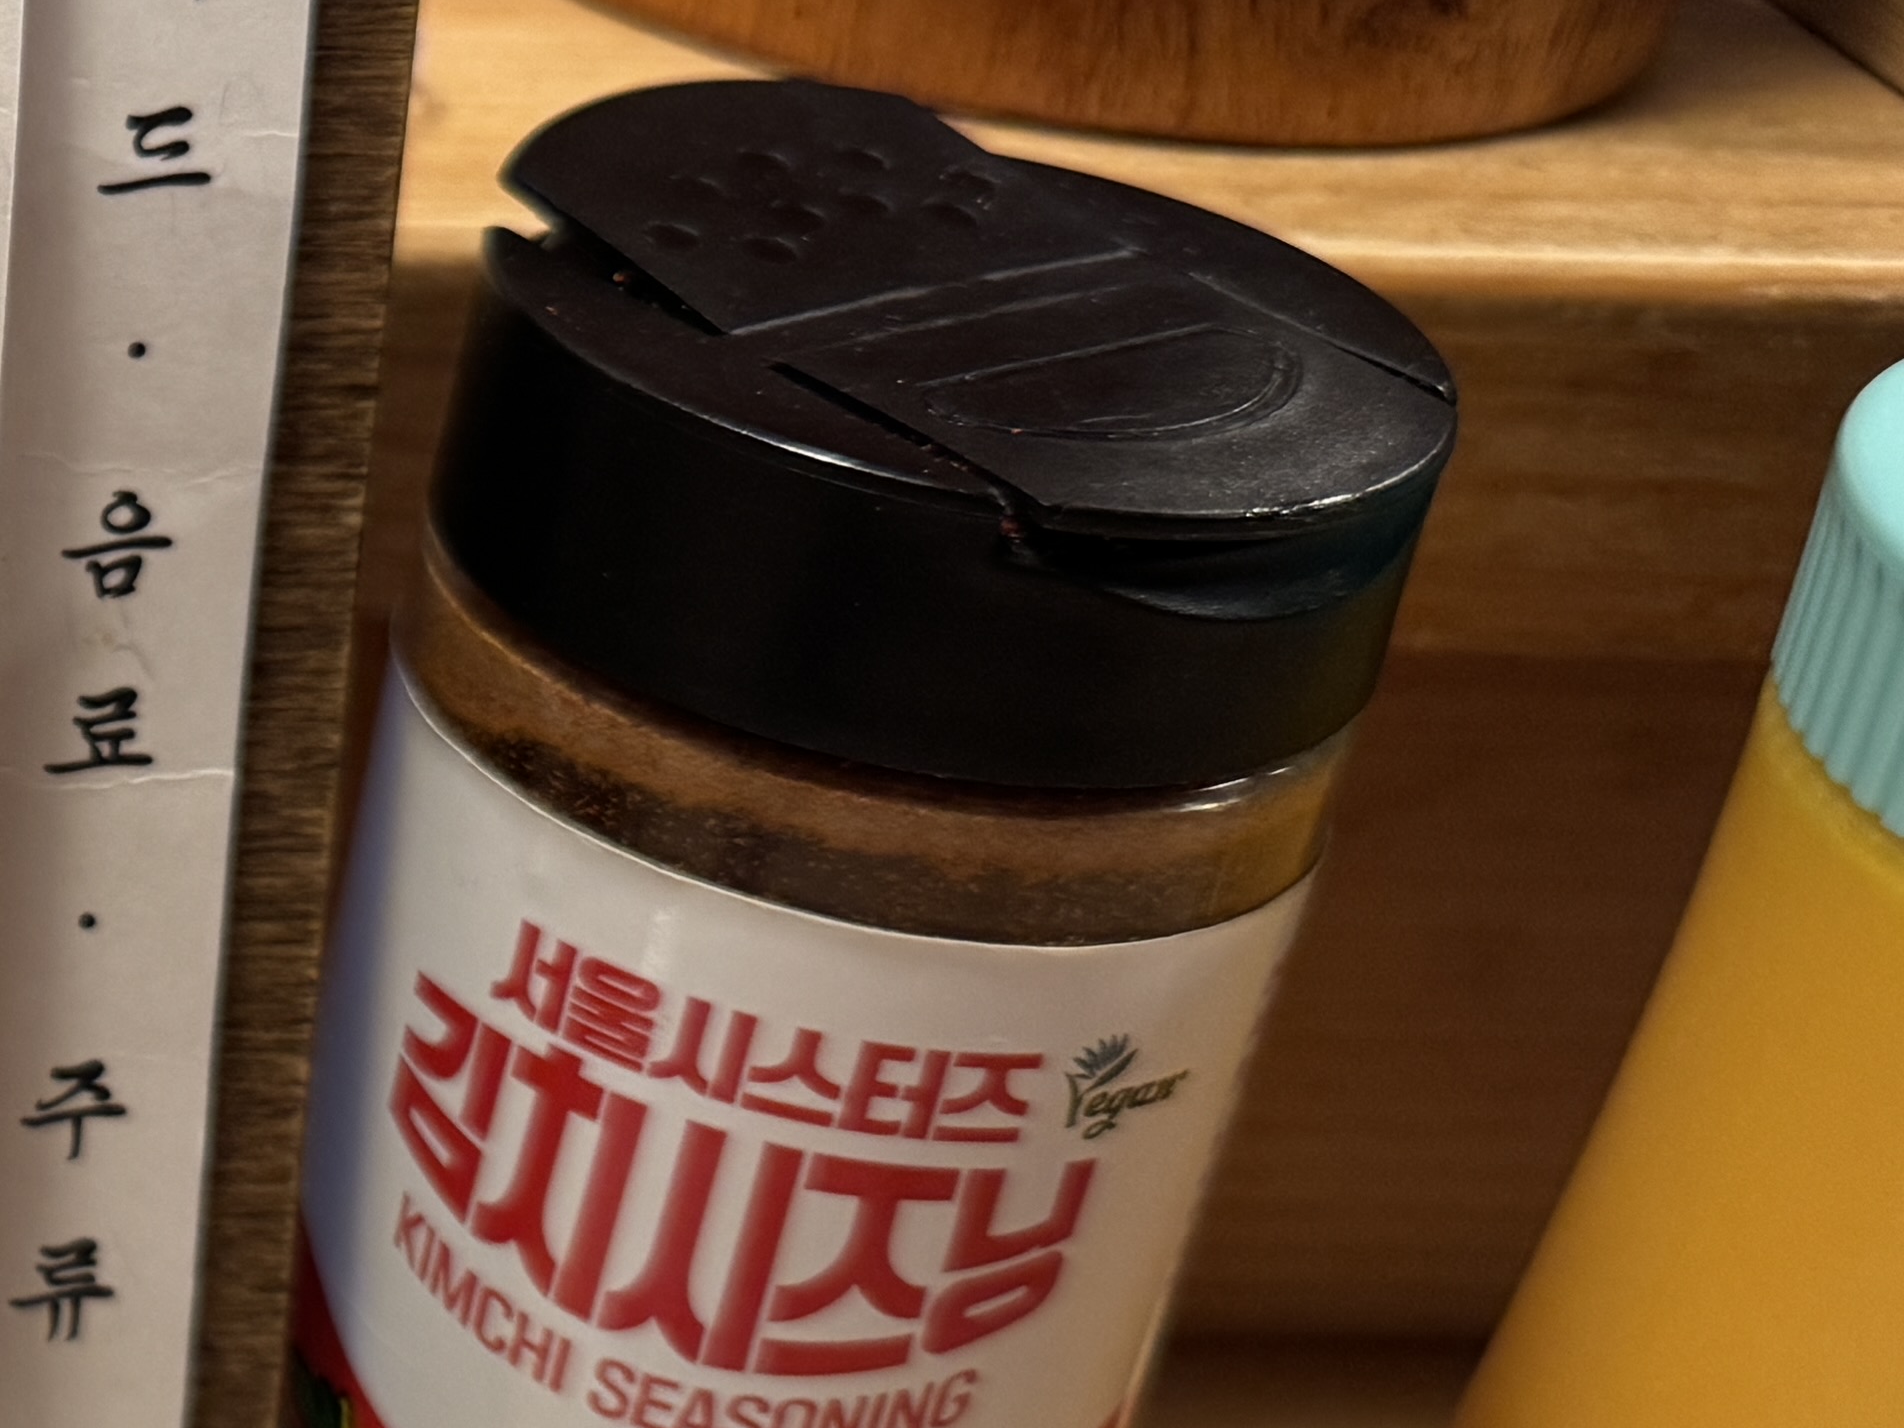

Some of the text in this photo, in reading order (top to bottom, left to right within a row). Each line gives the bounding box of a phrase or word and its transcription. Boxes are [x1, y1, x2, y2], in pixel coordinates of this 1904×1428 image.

[488, 918, 1043, 1143] 서울시스터즈
[391, 970, 1096, 1374] 김치시즈닝
[393, 1191, 574, 1392] KIMCHI
